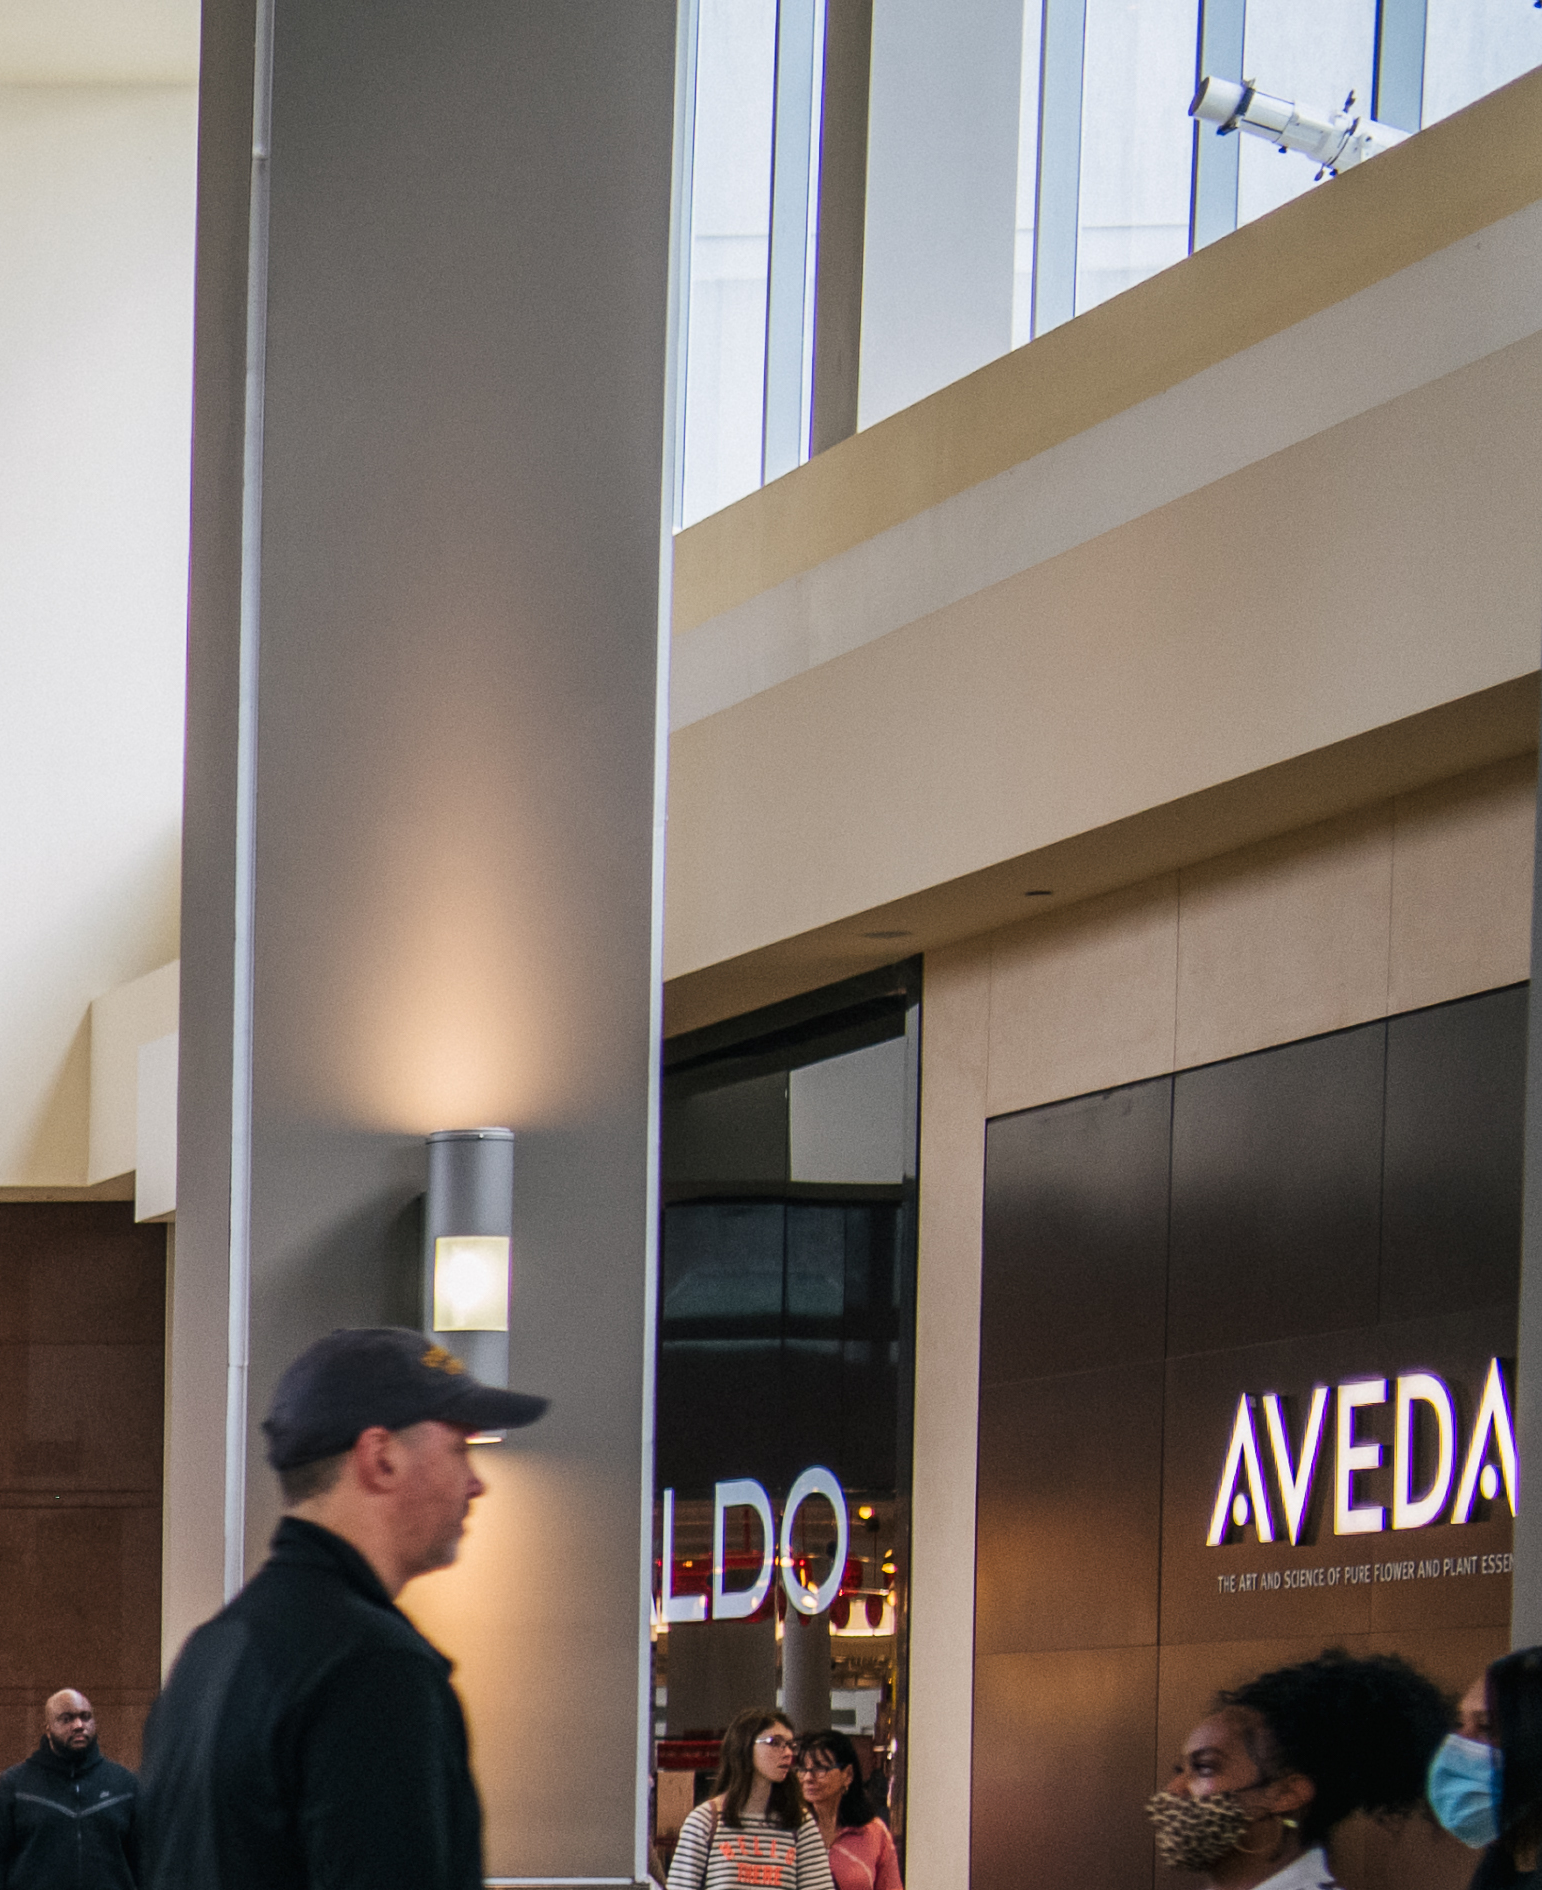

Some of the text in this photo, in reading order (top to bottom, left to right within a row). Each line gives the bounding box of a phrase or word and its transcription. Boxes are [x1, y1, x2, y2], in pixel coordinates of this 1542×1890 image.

[1205, 1356, 1522, 1547] AVEDA
[651, 1465, 850, 1625] LDO
[1218, 1574, 1236, 1594] THE
[1238, 1573, 1258, 1592] ART
[1260, 1571, 1281, 1590] AND
[1283, 1568, 1325, 1589] SCIENCE
[1327, 1567, 1341, 1586] OF
[1344, 1564, 1372, 1585] PURE
[1373, 1560, 1415, 1583] FLOWER
[1417, 1559, 1440, 1579] AND
[1443, 1556, 1478, 1577] PLANT
[736, 1862, 784, 1886] THERE
